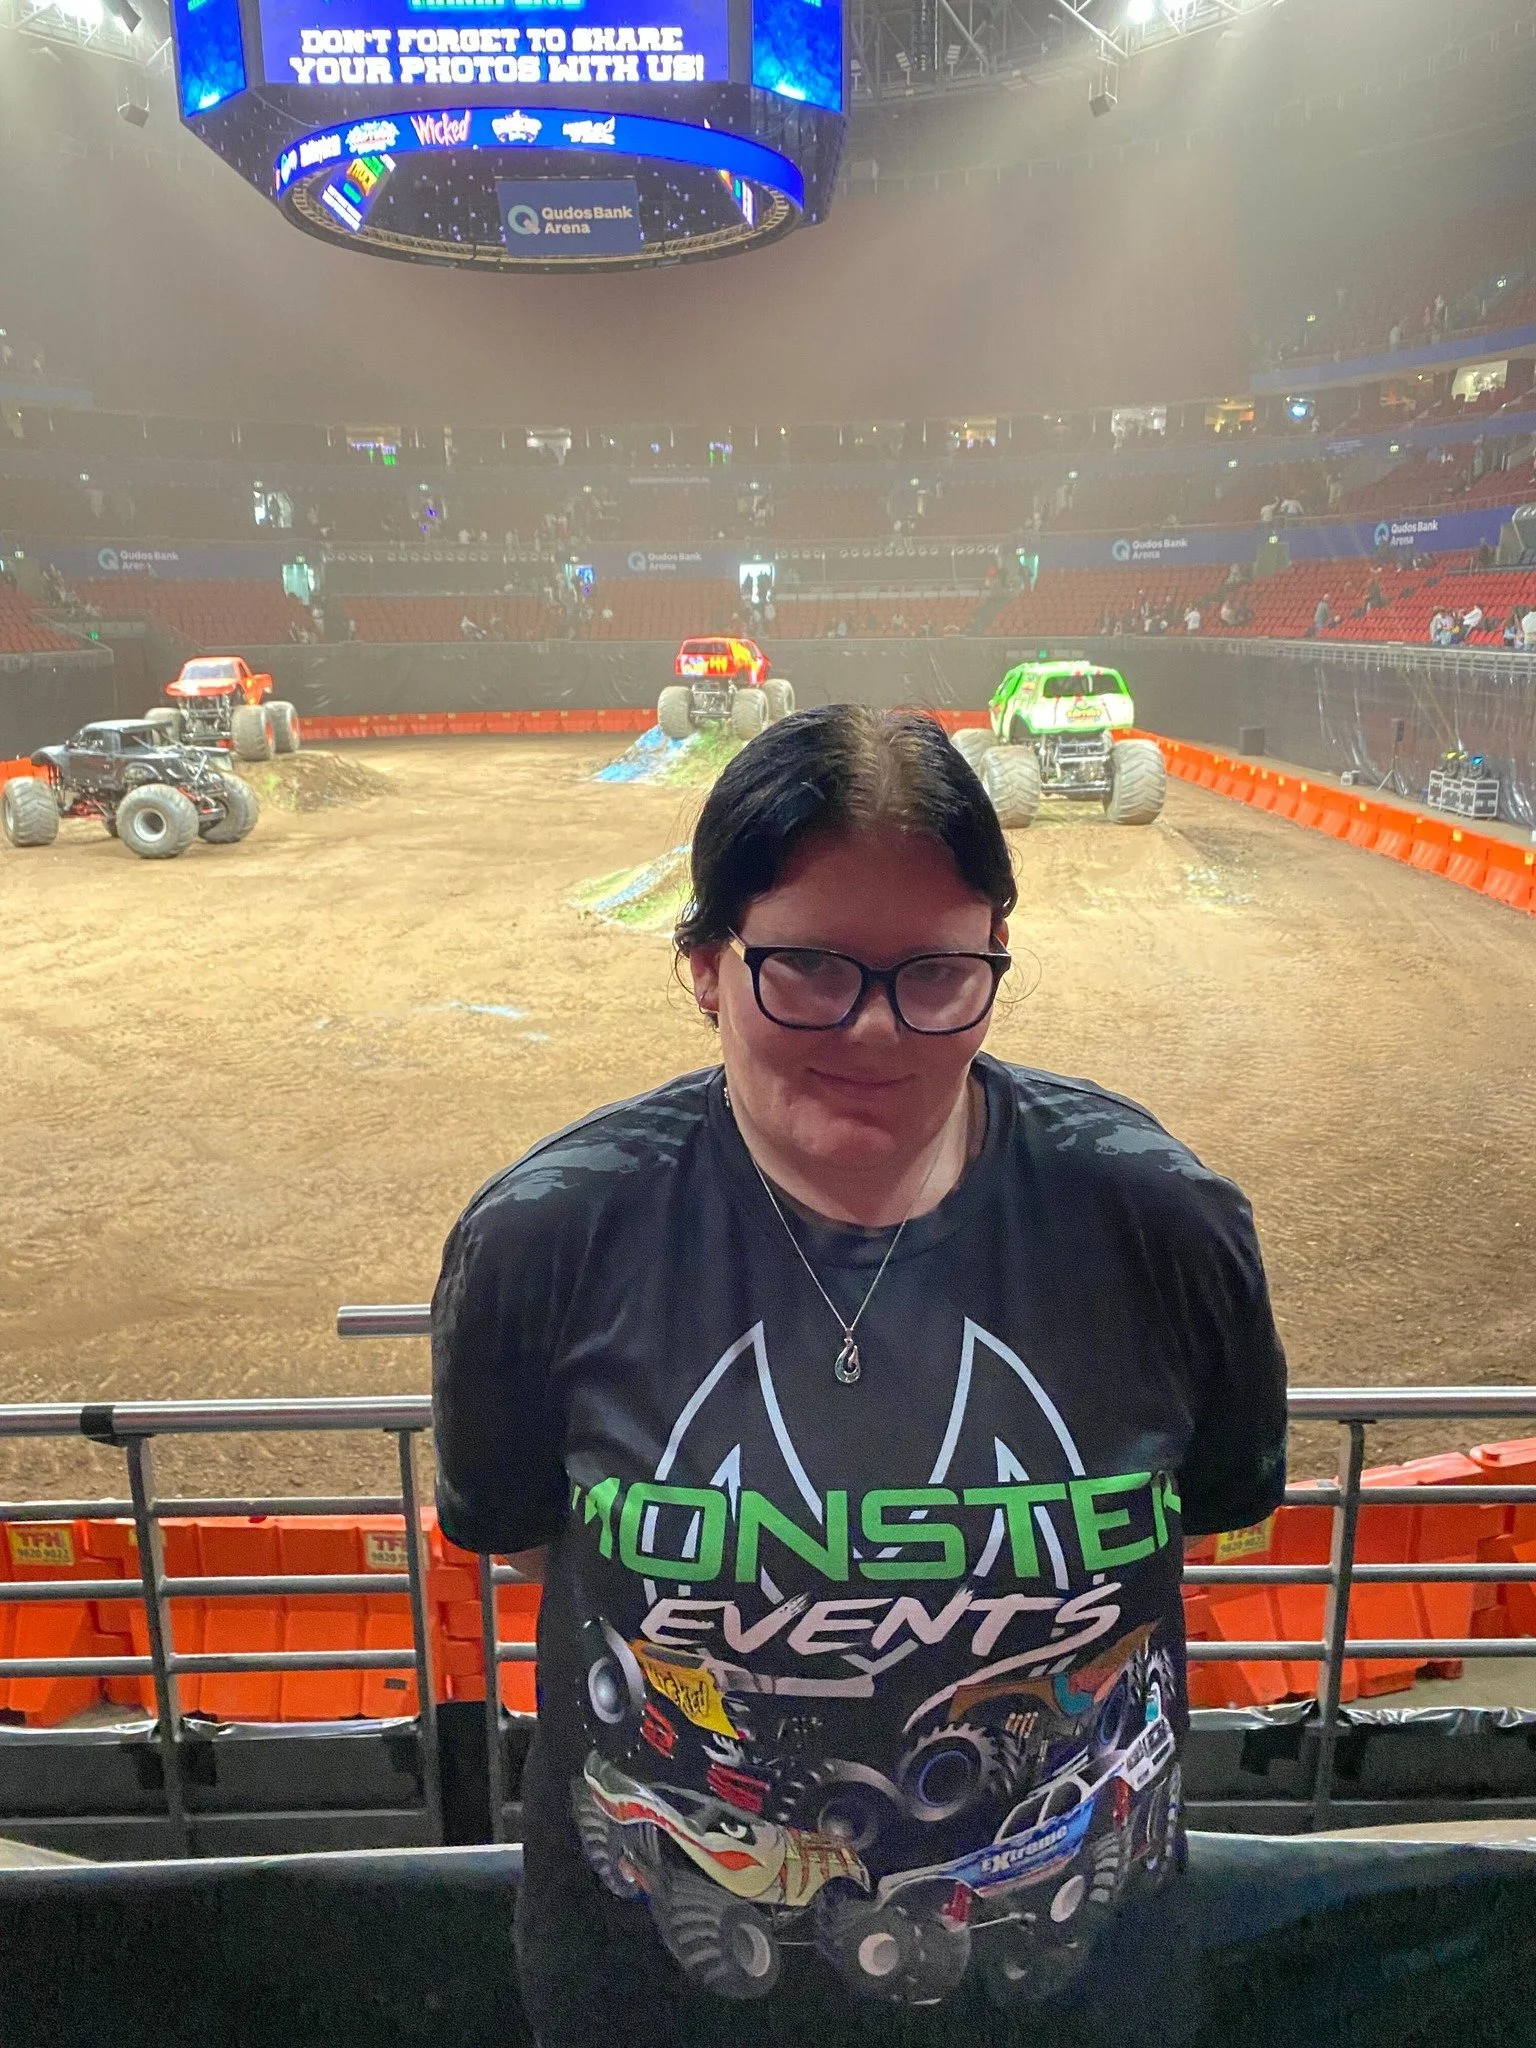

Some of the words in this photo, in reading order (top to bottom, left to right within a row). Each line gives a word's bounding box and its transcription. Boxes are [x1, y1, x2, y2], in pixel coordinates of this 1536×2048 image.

[301, 29, 392, 53] DON'T
[398, 28, 520, 53] FORGET
[526, 28, 566, 52] TO
[572, 27, 683, 51] SHARE
[289, 56, 393, 83] YOUR
[400, 55, 541, 83] PHOTOS
[549, 55, 639, 82] WITH
[646, 54, 704, 82] US!
[410, 109, 471, 146] Wicked
[541, 206, 593, 220] Qudos
[593, 205, 633, 219] Bank
[545, 222, 590, 234] Arena
[1391, 522, 1417, 534] Qudos
[1417, 519, 1438, 532] Bank
[1164, 538, 1188, 548] Bank
[371, 1535, 407, 1551] TF
[641, 1581, 1122, 1663] EVENTS
